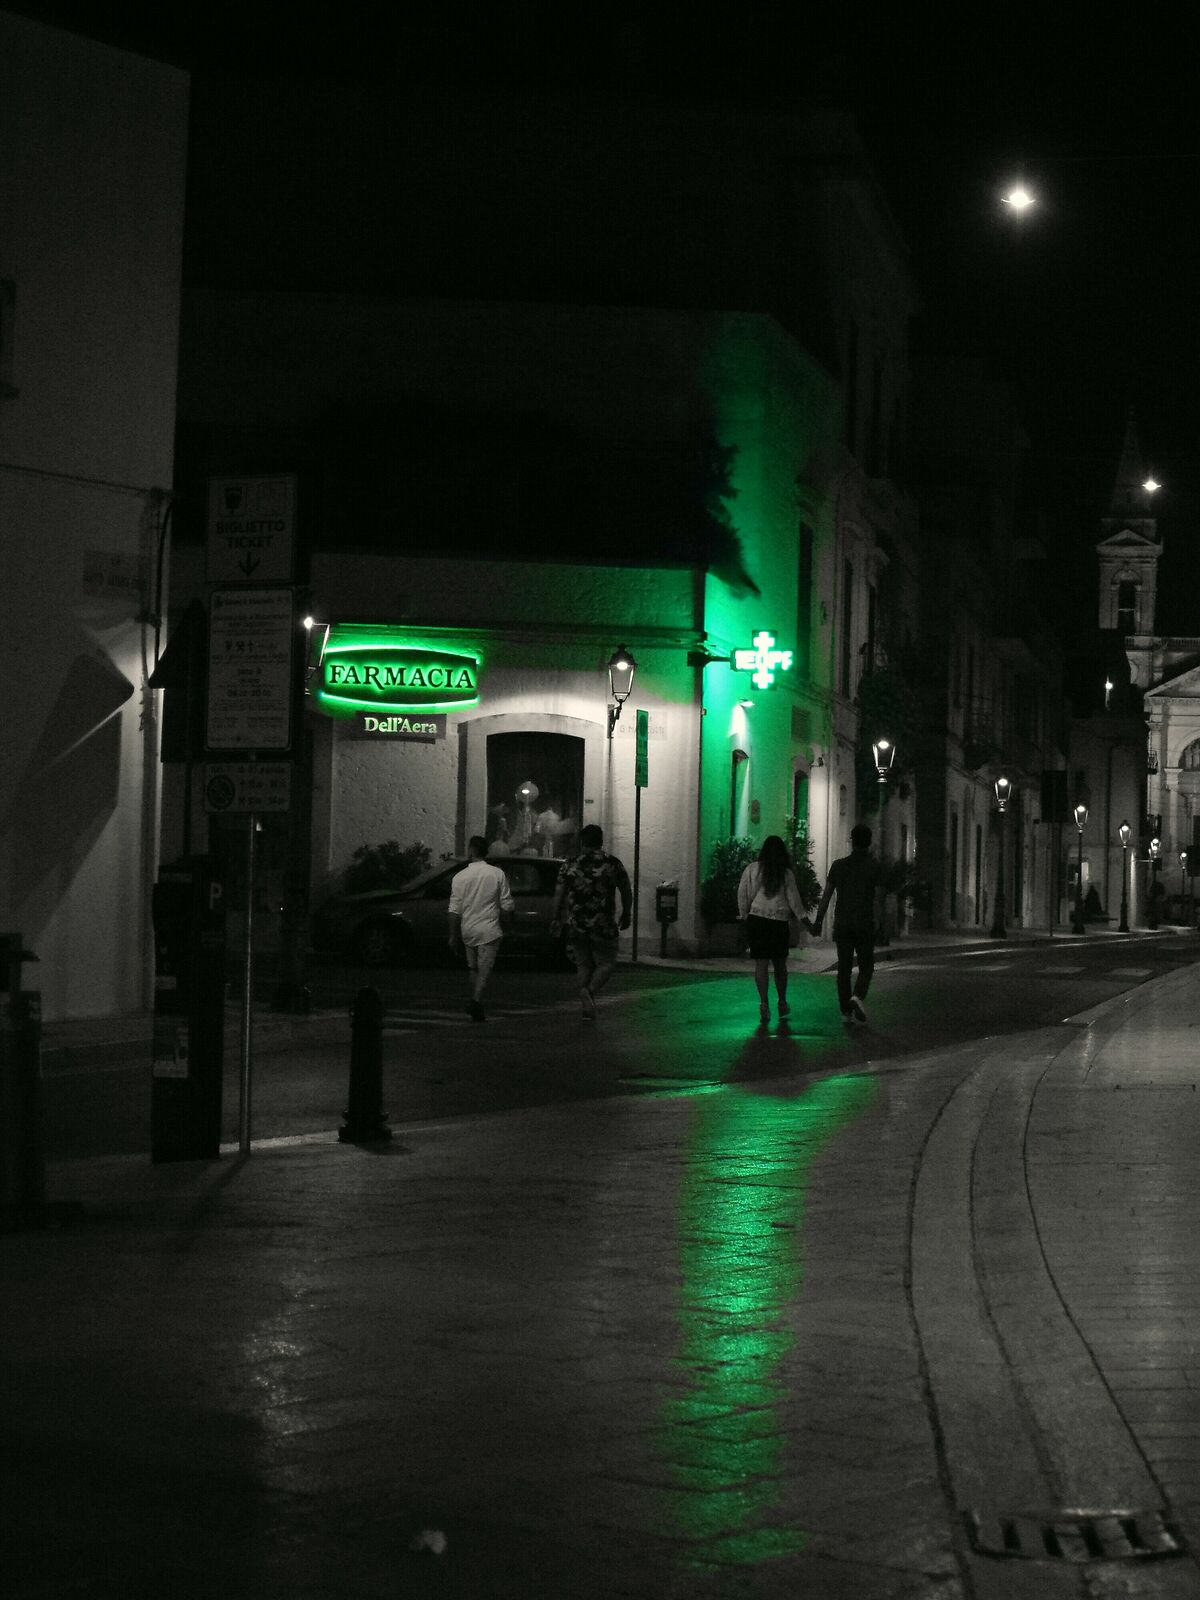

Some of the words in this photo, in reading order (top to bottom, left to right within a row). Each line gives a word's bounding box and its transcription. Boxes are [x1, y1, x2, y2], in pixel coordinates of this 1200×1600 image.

[216, 519, 285, 534] BIGLIETTO
[225, 535, 274, 548] TICKET
[329, 664, 474, 690] FARMACIA
[363, 716, 438, 734] Dell'Aera
